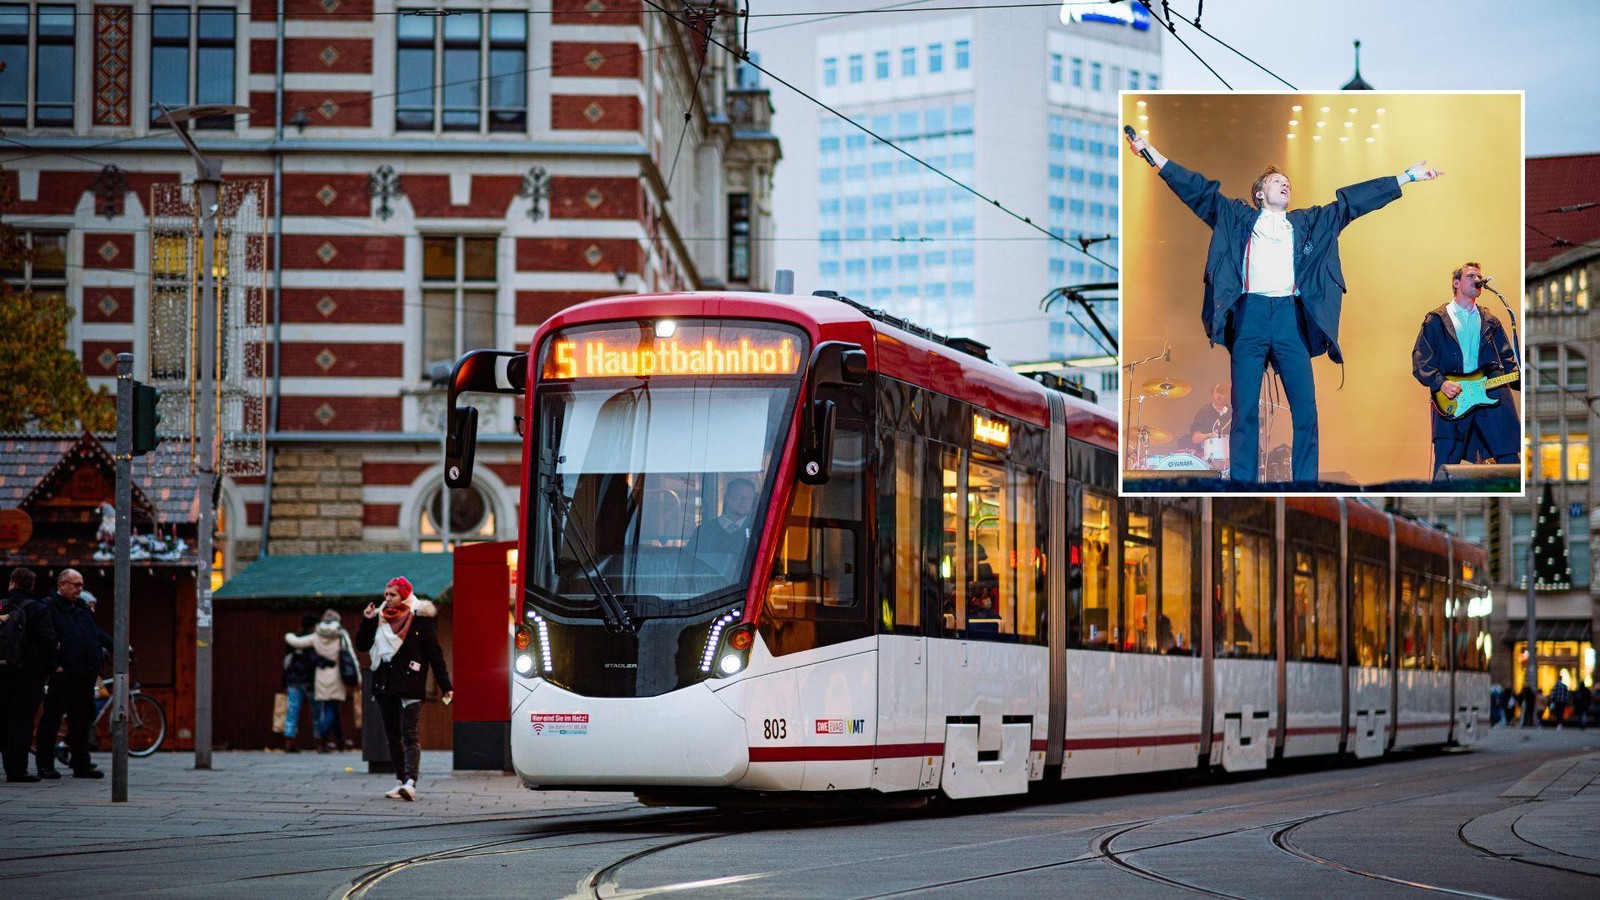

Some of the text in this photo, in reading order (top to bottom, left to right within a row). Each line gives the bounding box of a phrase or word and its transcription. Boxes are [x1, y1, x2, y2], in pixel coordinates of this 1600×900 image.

[556, 339, 792, 378] 5 Hauptbahnhof
[763, 718, 787, 739] 803
[847, 719, 865, 733] VMT
